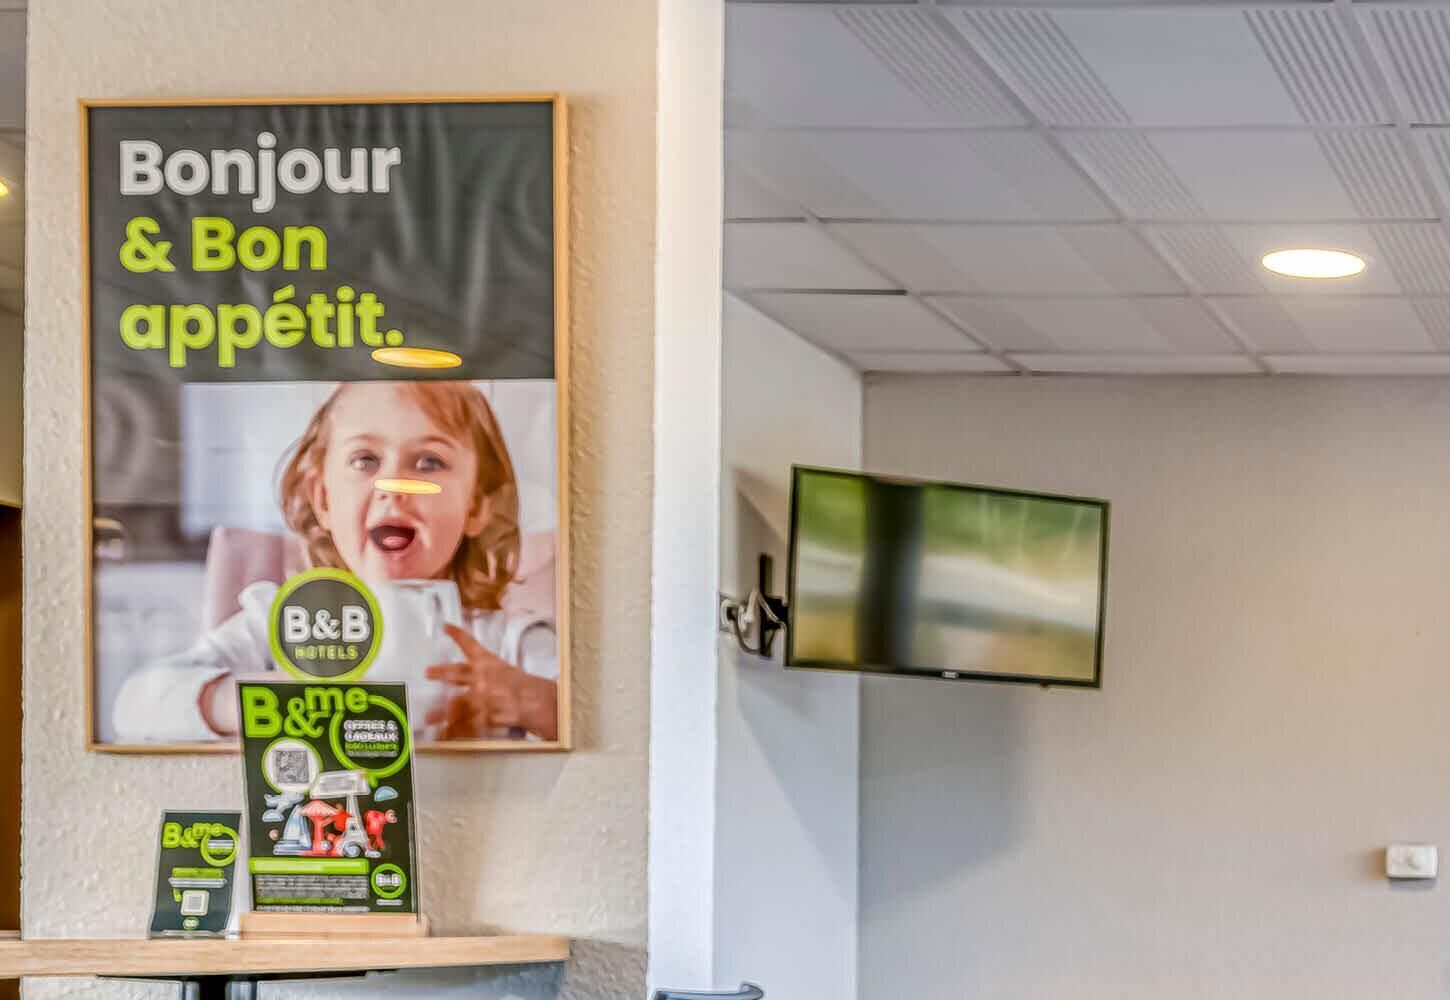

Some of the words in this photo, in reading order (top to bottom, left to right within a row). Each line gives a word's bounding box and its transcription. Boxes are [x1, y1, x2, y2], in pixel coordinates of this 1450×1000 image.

[119, 131, 401, 213] Bonjour
[119, 217, 175, 272] &
[191, 217, 327, 271] Bon
[119, 284, 405, 368] appétit.
[284, 605, 371, 643] B&B
[295, 645, 359, 660] HOTELS
